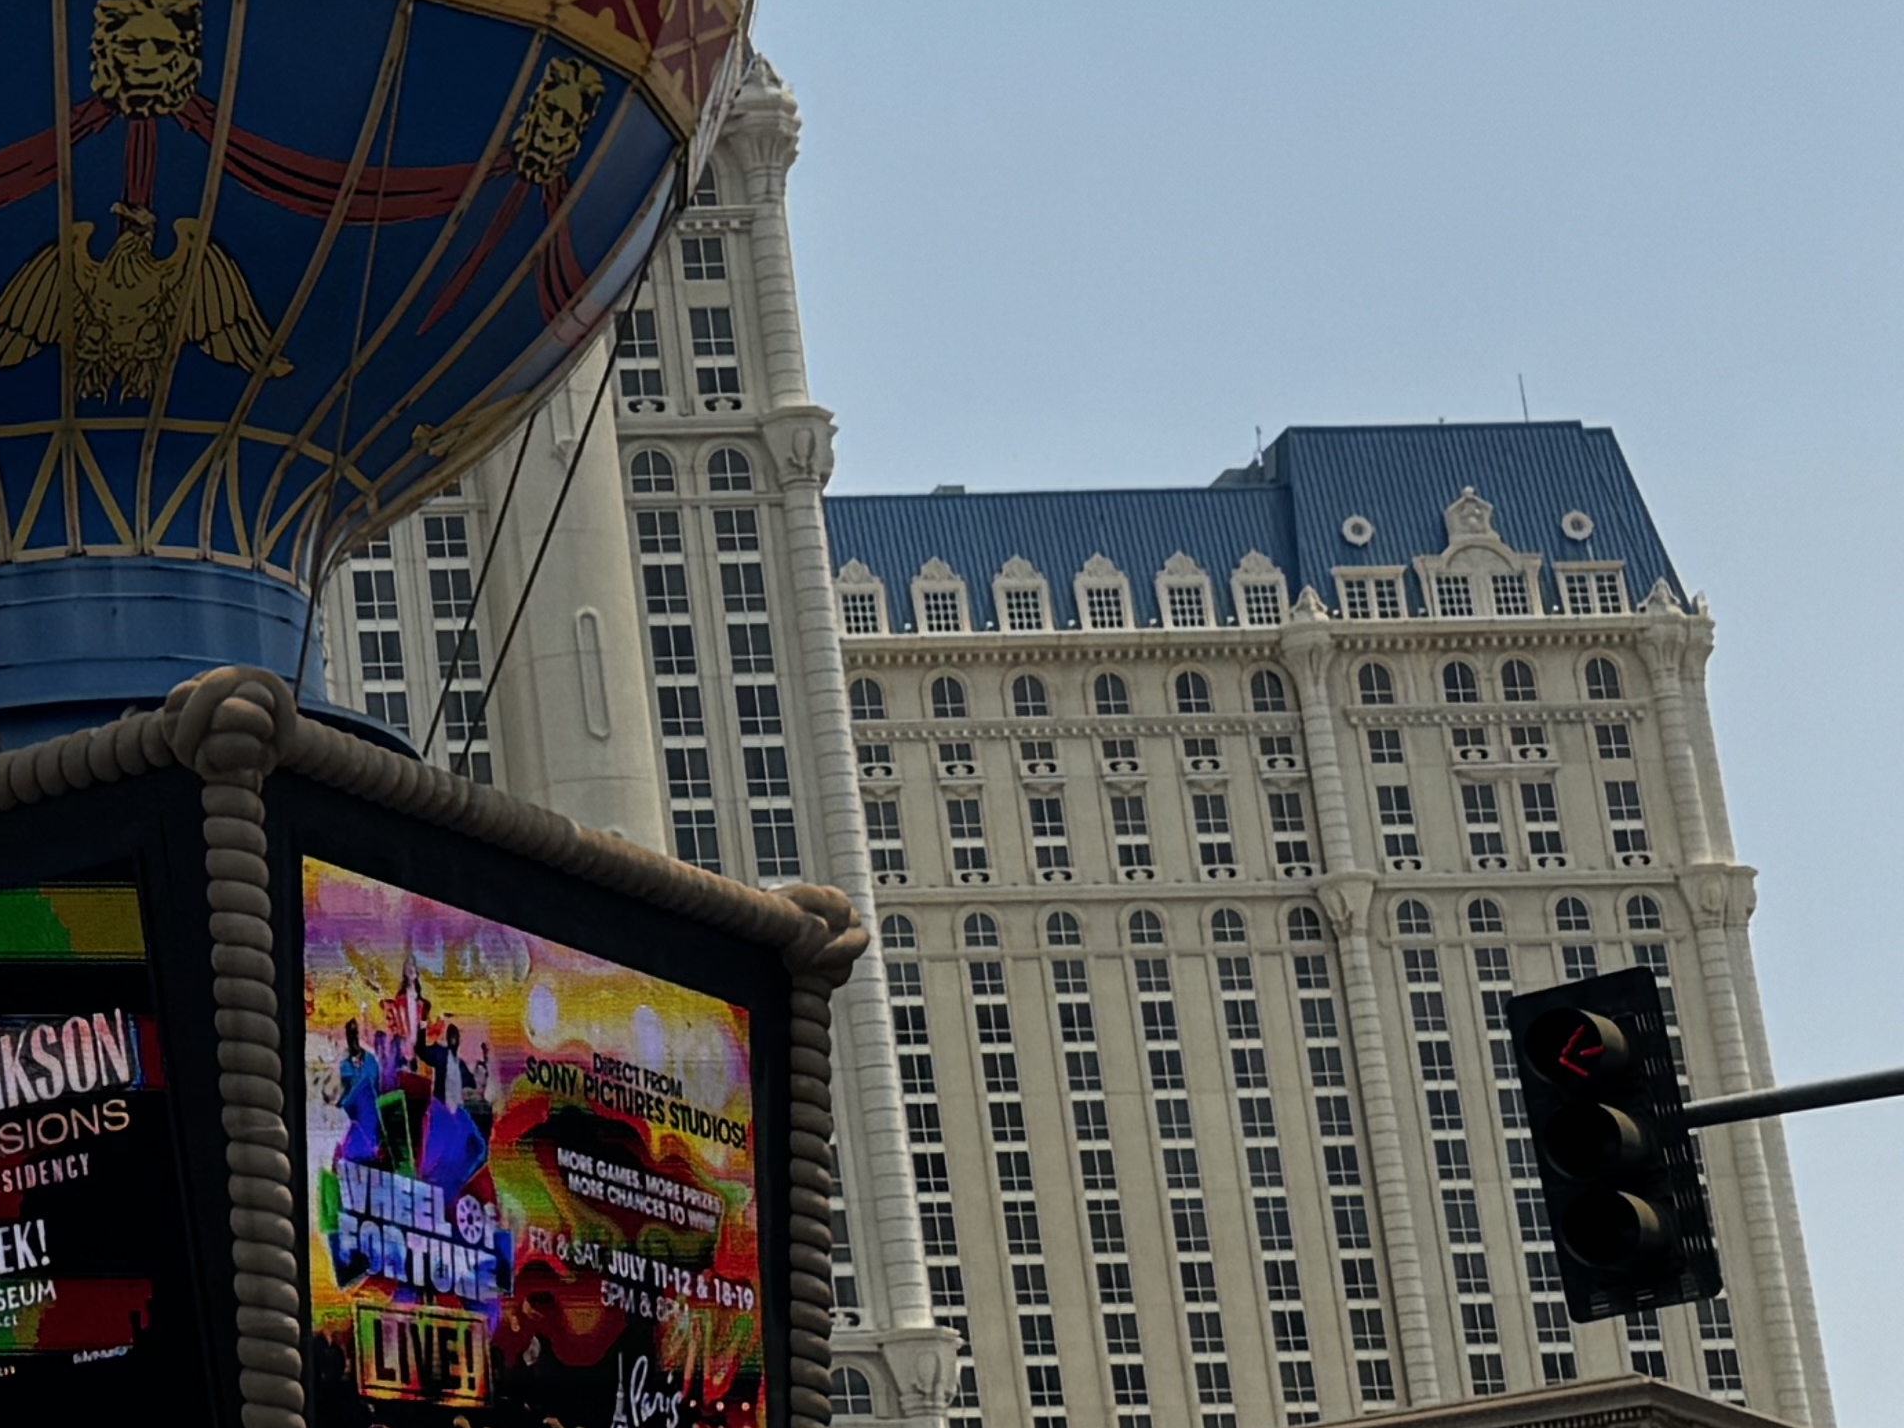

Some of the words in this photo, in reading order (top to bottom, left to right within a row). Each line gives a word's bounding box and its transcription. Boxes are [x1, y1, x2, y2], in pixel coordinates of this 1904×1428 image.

[526, 1056, 577, 1096] SONY
[583, 1074, 665, 1124] PICTURES
[669, 1101, 746, 1150] STUDIOS!
[593, 1052, 639, 1086] DIRECT
[645, 1068, 682, 1099] FROM
[336, 1157, 452, 1238] WHEEL
[557, 1146, 594, 1175] MORE
[645, 1173, 680, 1202] MORE
[568, 1172, 604, 1202] MORE
[607, 1183, 666, 1221] CHANCES
[668, 1204, 686, 1225] TO
[337, 1210, 499, 1304] FORTUNE
[529, 1225, 553, 1255] FRI
[608, 1249, 647, 1283] JULY
[696, 1274, 708, 1300] &
[600, 1279, 636, 1315] 5PM
[639, 1291, 653, 1319] &
[374, 1317, 477, 1391] LIVE!
